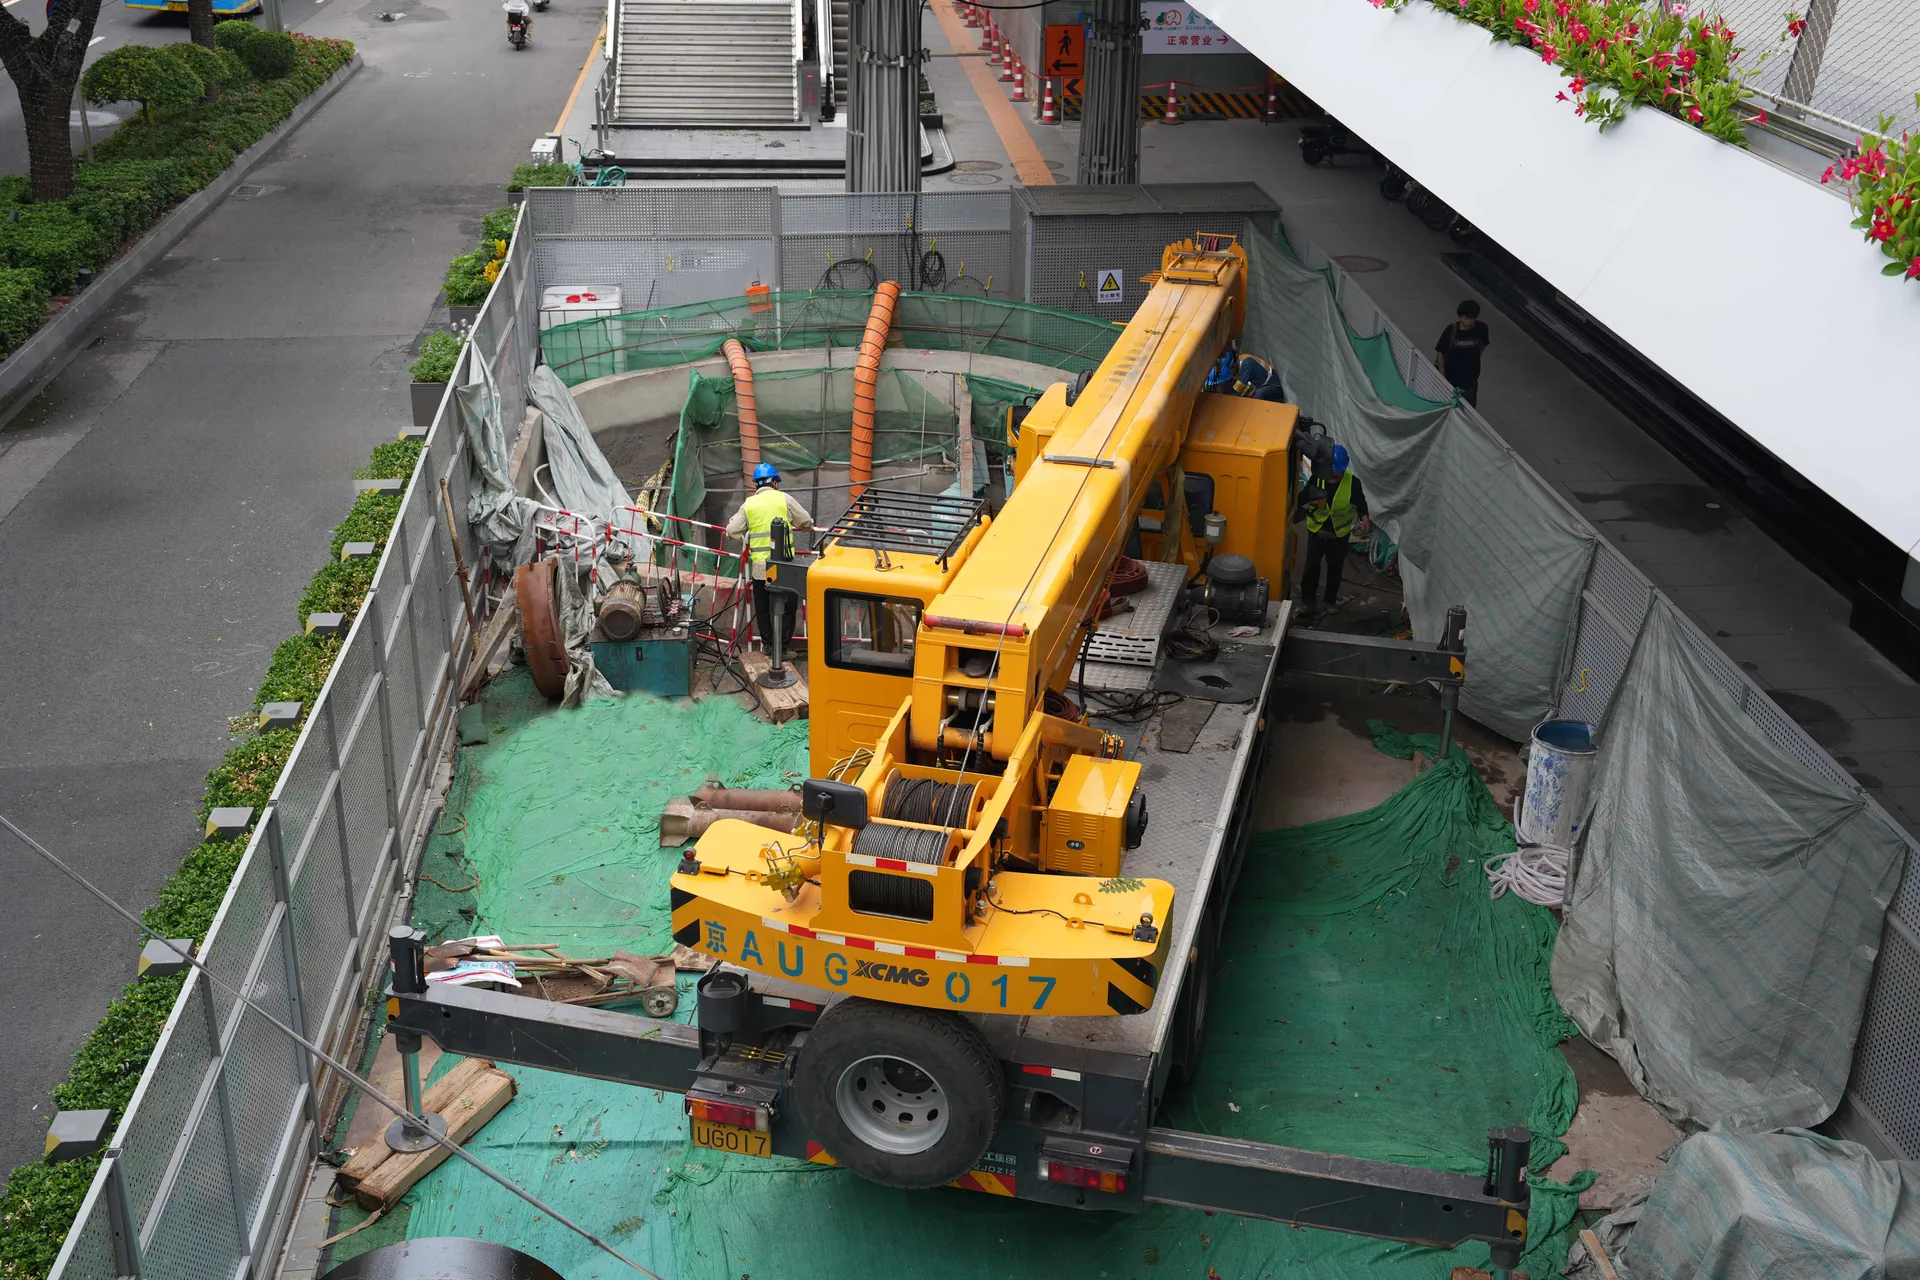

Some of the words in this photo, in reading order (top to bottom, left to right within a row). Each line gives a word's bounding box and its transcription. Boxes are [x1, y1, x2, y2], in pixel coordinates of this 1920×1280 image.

[1167, 35, 1212, 46] 正常营业
[851, 958, 930, 987] XCMG
[697, 1126, 767, 1155] UG017
[983, 1151, 1016, 1165] 工集团
